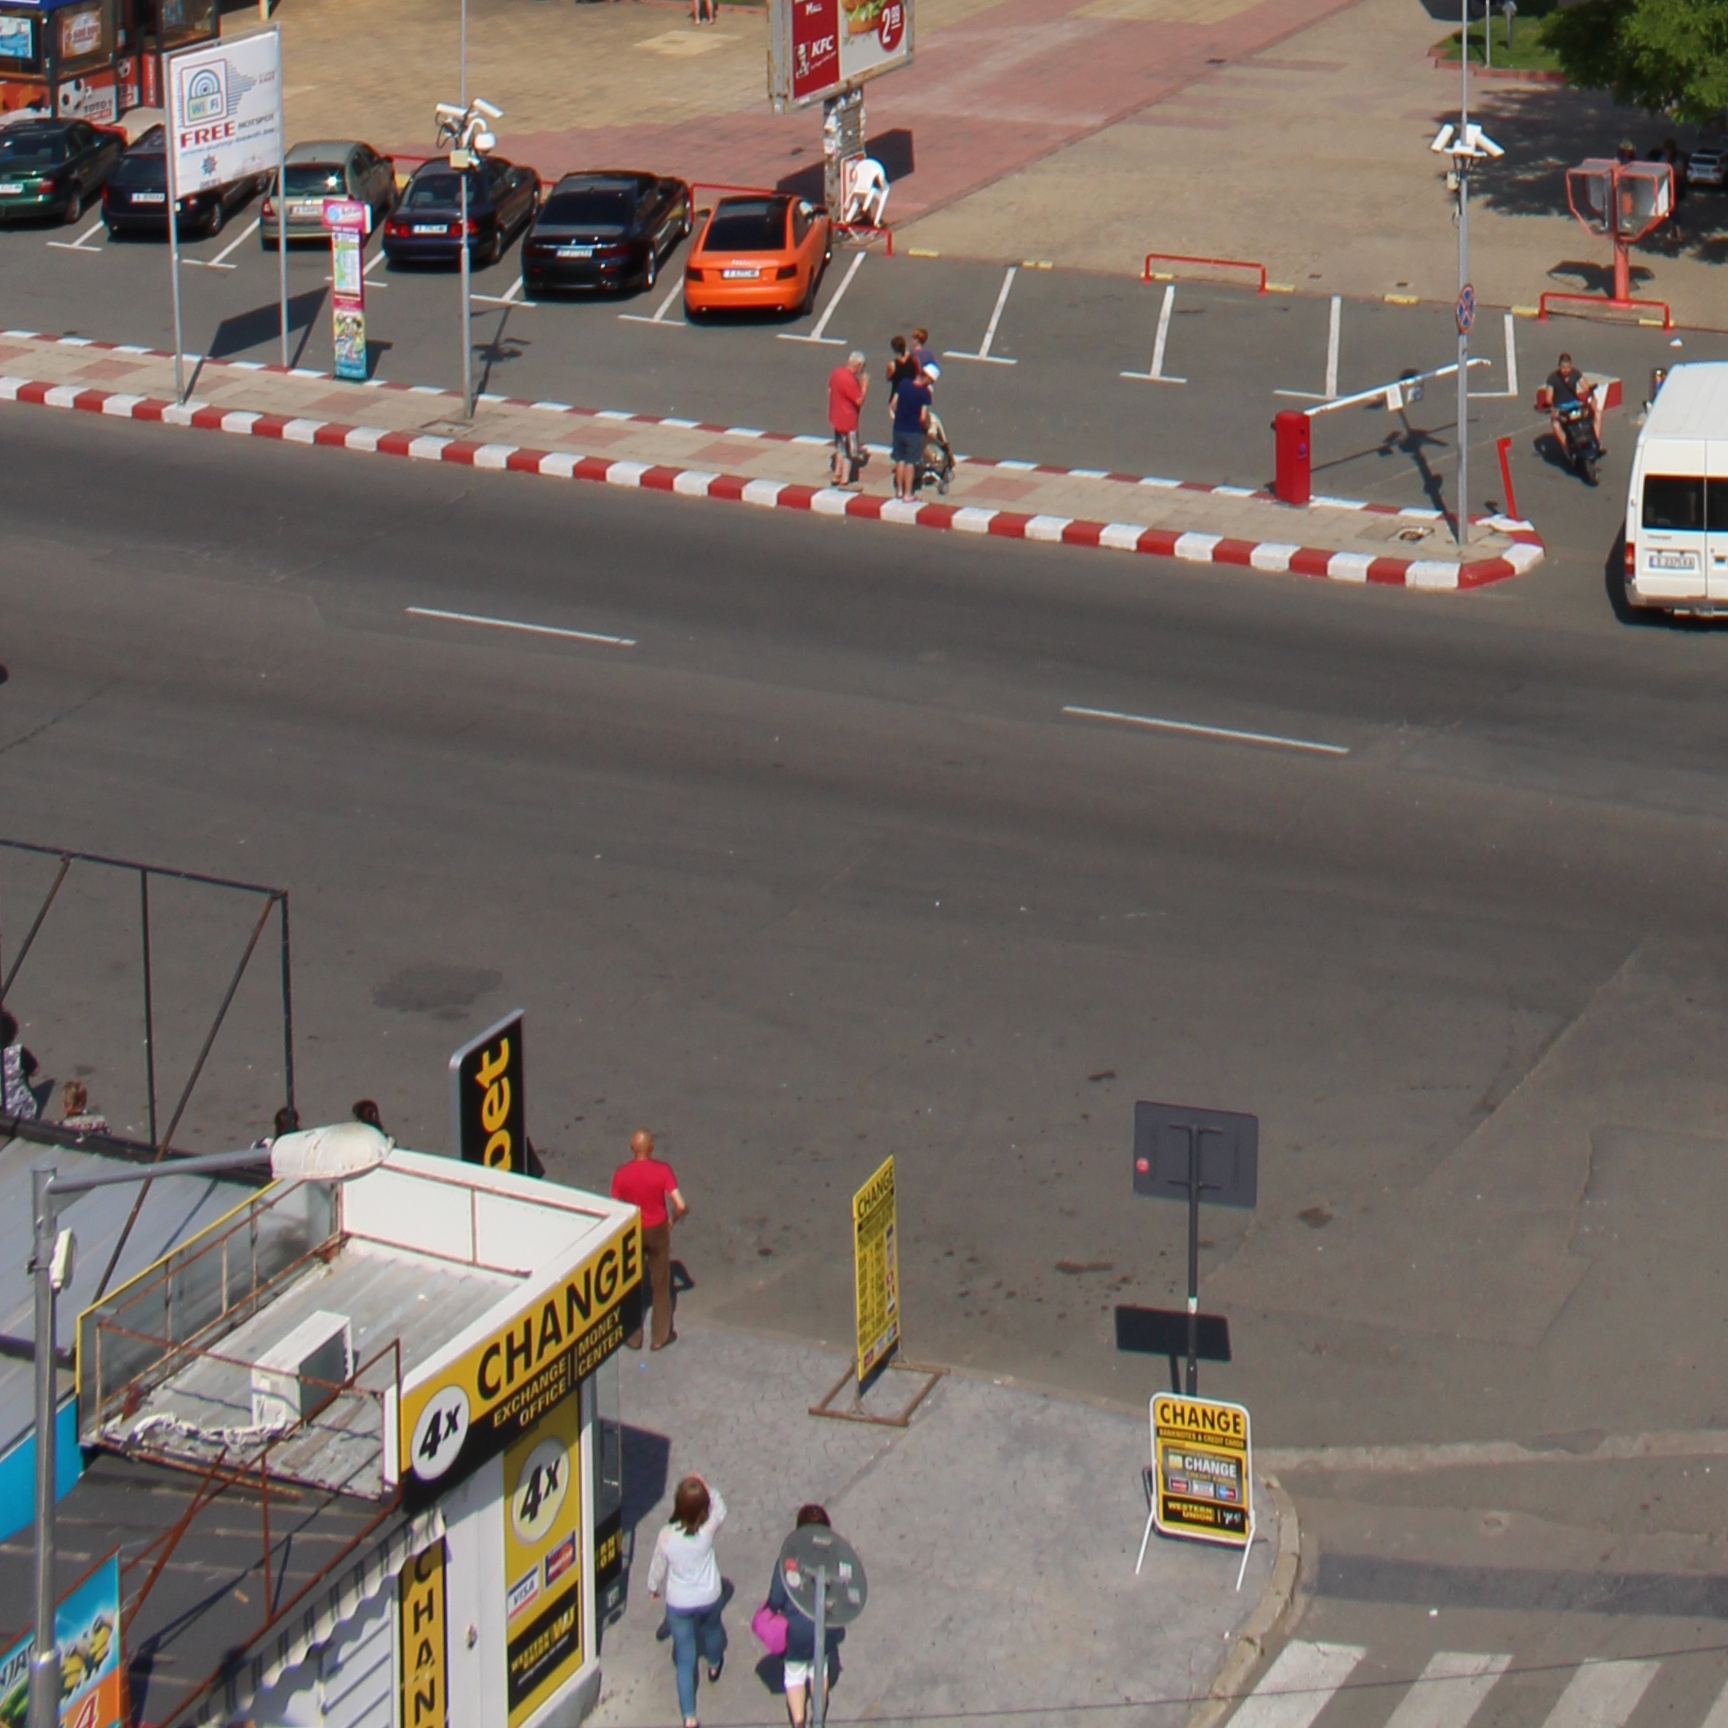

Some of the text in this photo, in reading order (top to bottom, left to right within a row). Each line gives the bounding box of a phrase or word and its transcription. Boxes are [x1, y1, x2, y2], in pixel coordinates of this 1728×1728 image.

[811, 35, 834, 58] KFC
[180, 113, 274, 149] FREE HOTSPOT
[857, 1164, 894, 1219] CHANGE
[477, 1225, 637, 1400] CHANGE
[493, 1306, 621, 1429] EXCHANGE MONEY
[519, 1324, 624, 1427] OFFICE CENTER
[1160, 1403, 1241, 1434] CHANGE
[1159, 1428, 1197, 1441] BANKNOTES
[1184, 1456, 1237, 1478] CHANGE
[1168, 1501, 1215, 1516] WESTERN
[1182, 1508, 1215, 1522] UNION
[513, 1580, 535, 1605] VISA
